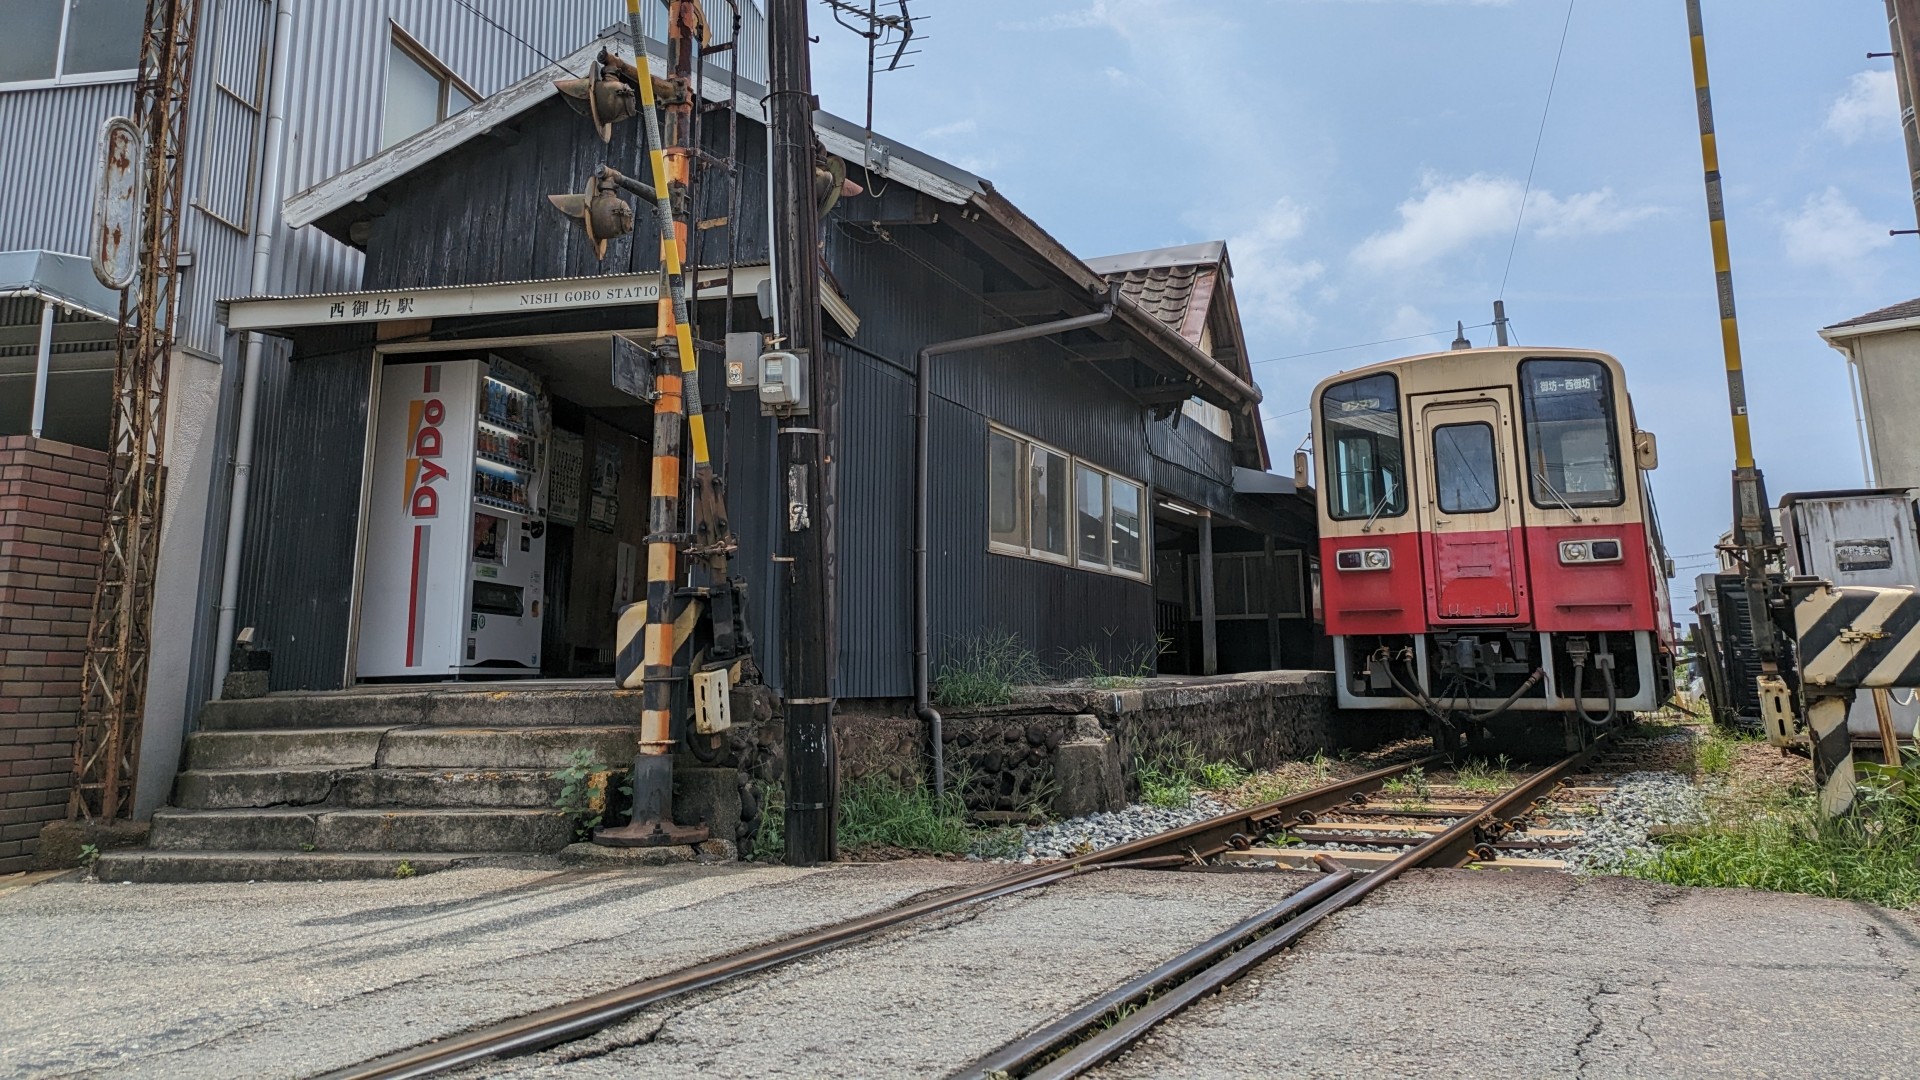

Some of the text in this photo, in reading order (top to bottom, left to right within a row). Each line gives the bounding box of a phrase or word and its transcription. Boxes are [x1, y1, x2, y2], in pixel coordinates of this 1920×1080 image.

[520, 285, 658, 306] NISHI GOBO STATIO
[329, 297, 414, 319] 西御坊駅
[412, 399, 448, 518] DyDo
